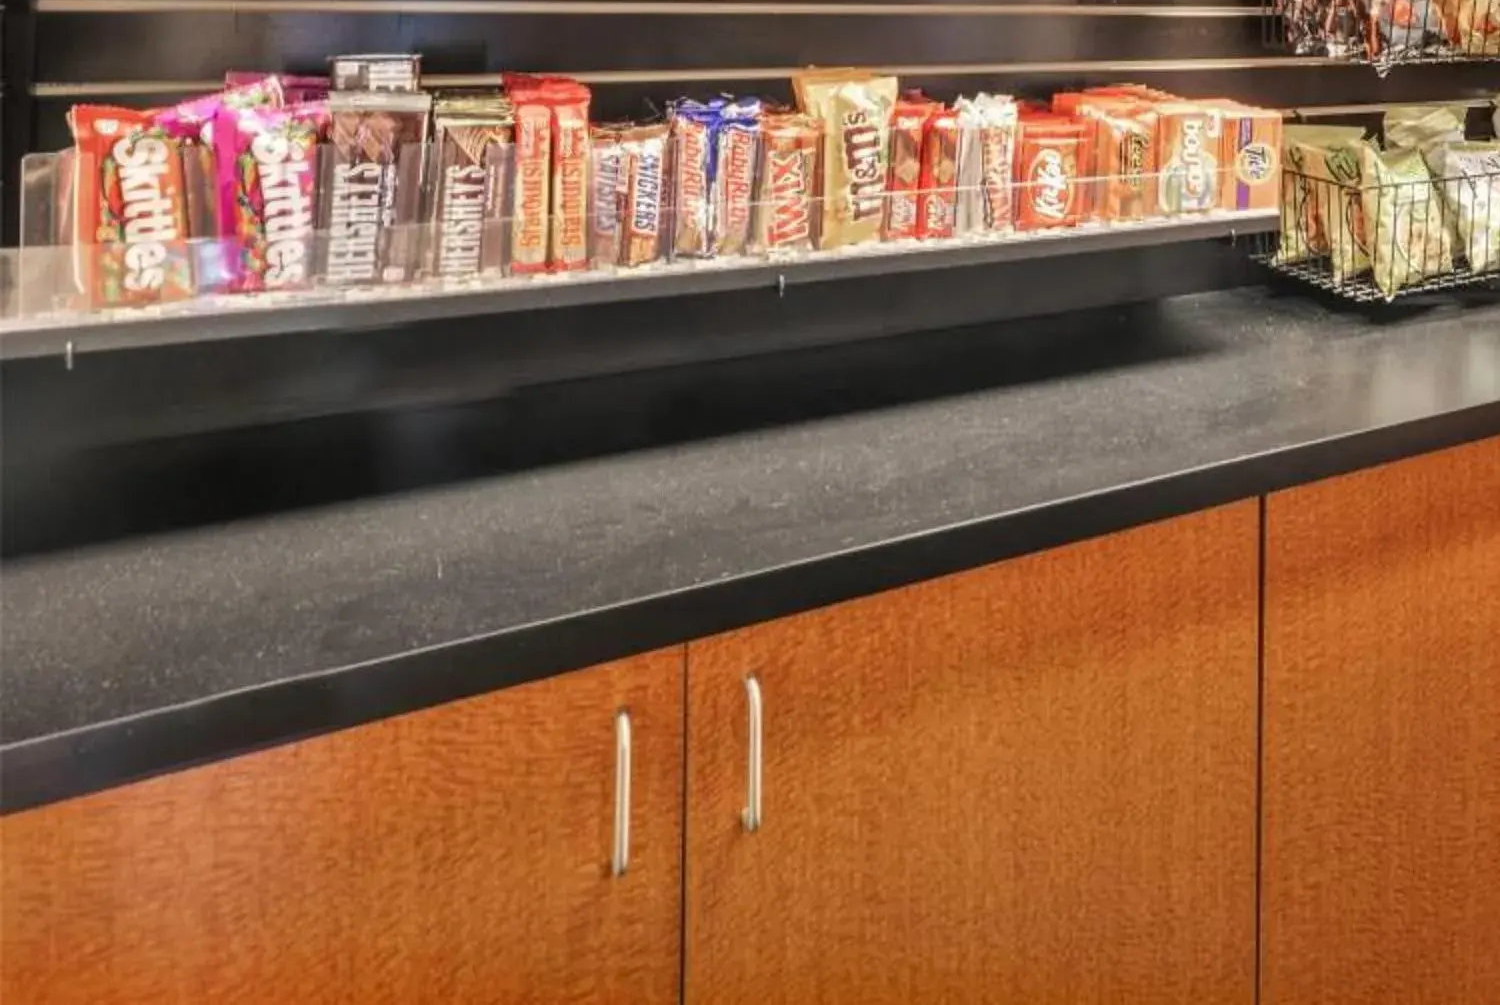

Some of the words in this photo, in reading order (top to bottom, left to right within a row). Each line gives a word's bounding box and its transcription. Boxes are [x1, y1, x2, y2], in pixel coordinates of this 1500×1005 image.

[113, 137, 179, 292] Skittles
[252, 132, 313, 287] Skittles
[326, 162, 383, 281] HERSHEY'S
[439, 164, 487, 274] HERSHEY'S
[632, 152, 662, 234] SNICKERS
[767, 151, 810, 243] TWIX
